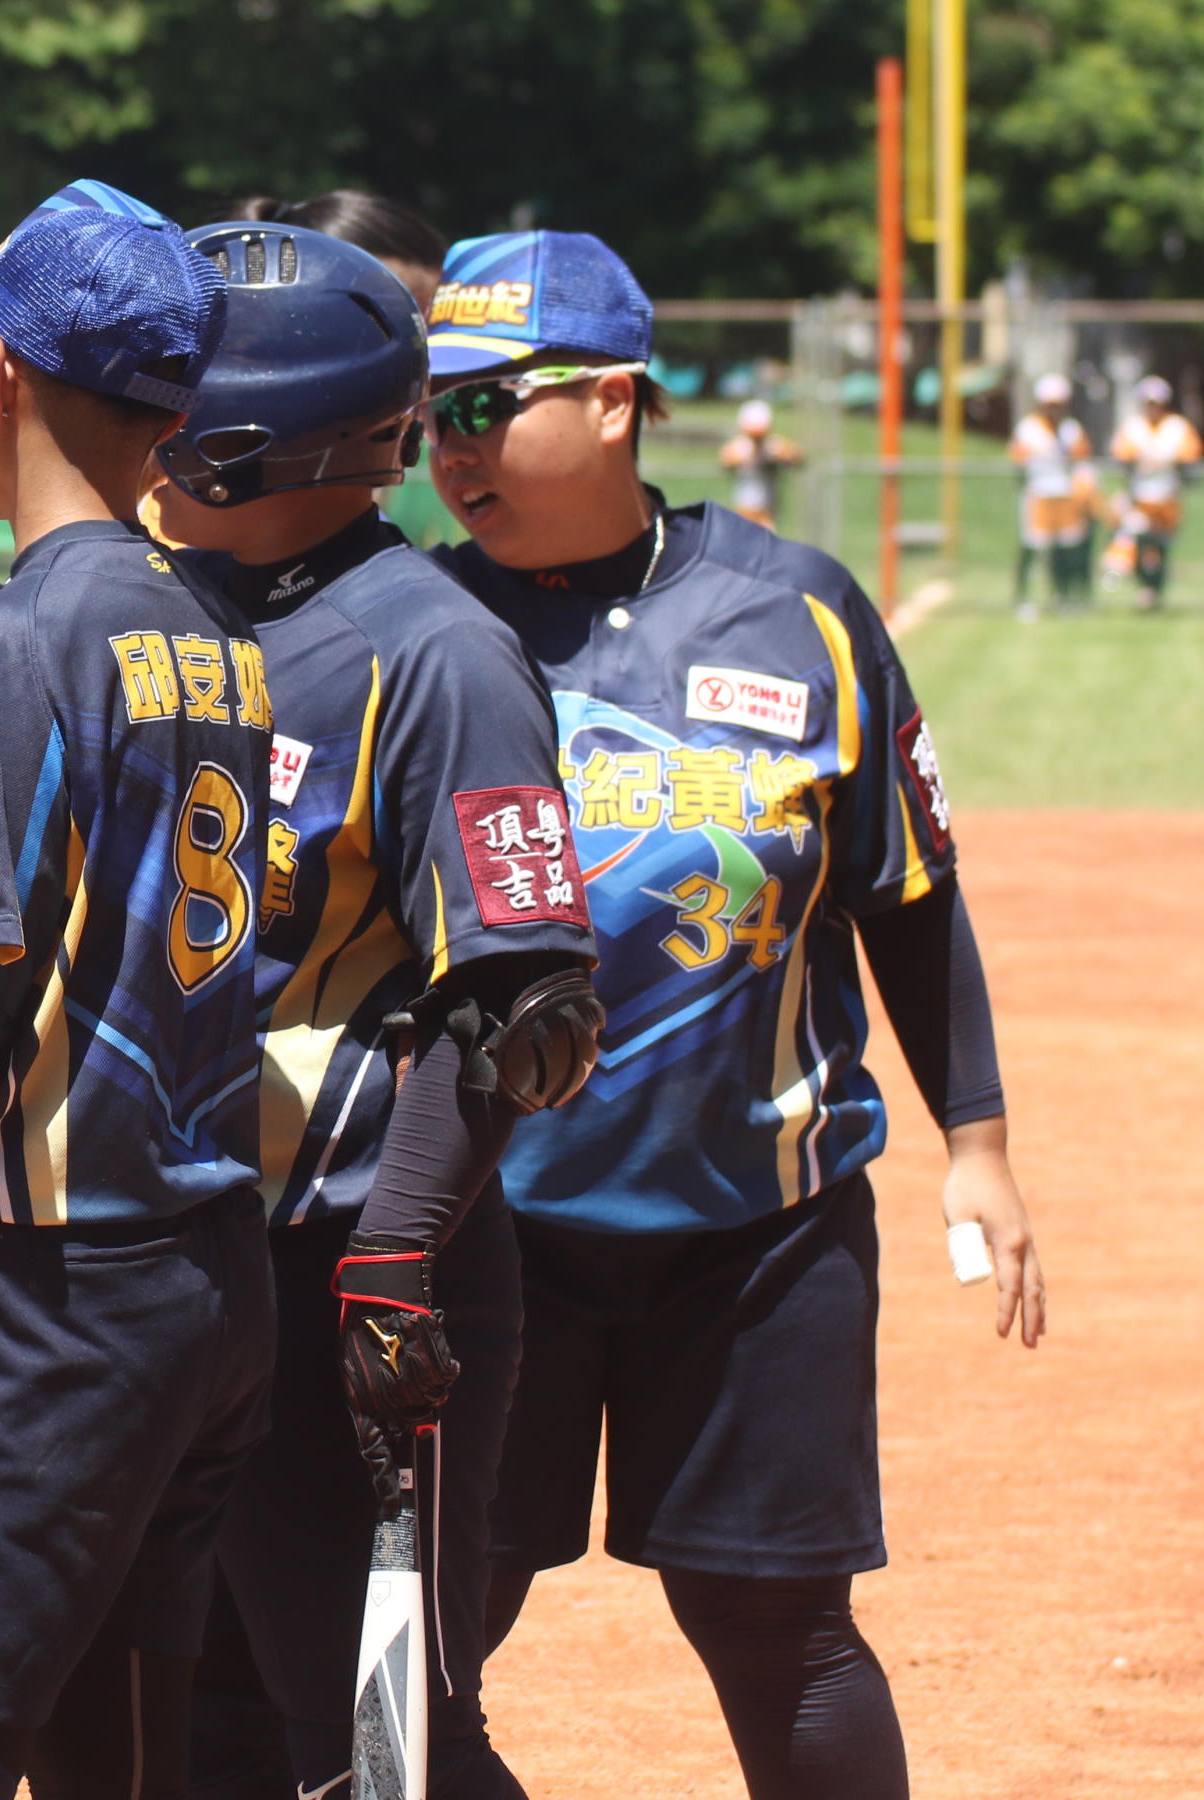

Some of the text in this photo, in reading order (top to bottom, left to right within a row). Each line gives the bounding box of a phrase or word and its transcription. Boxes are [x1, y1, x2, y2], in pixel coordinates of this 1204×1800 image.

[429, 280, 533, 327] 新世紀
[166, 760, 254, 997] 8
[658, 871, 786, 972] 34
